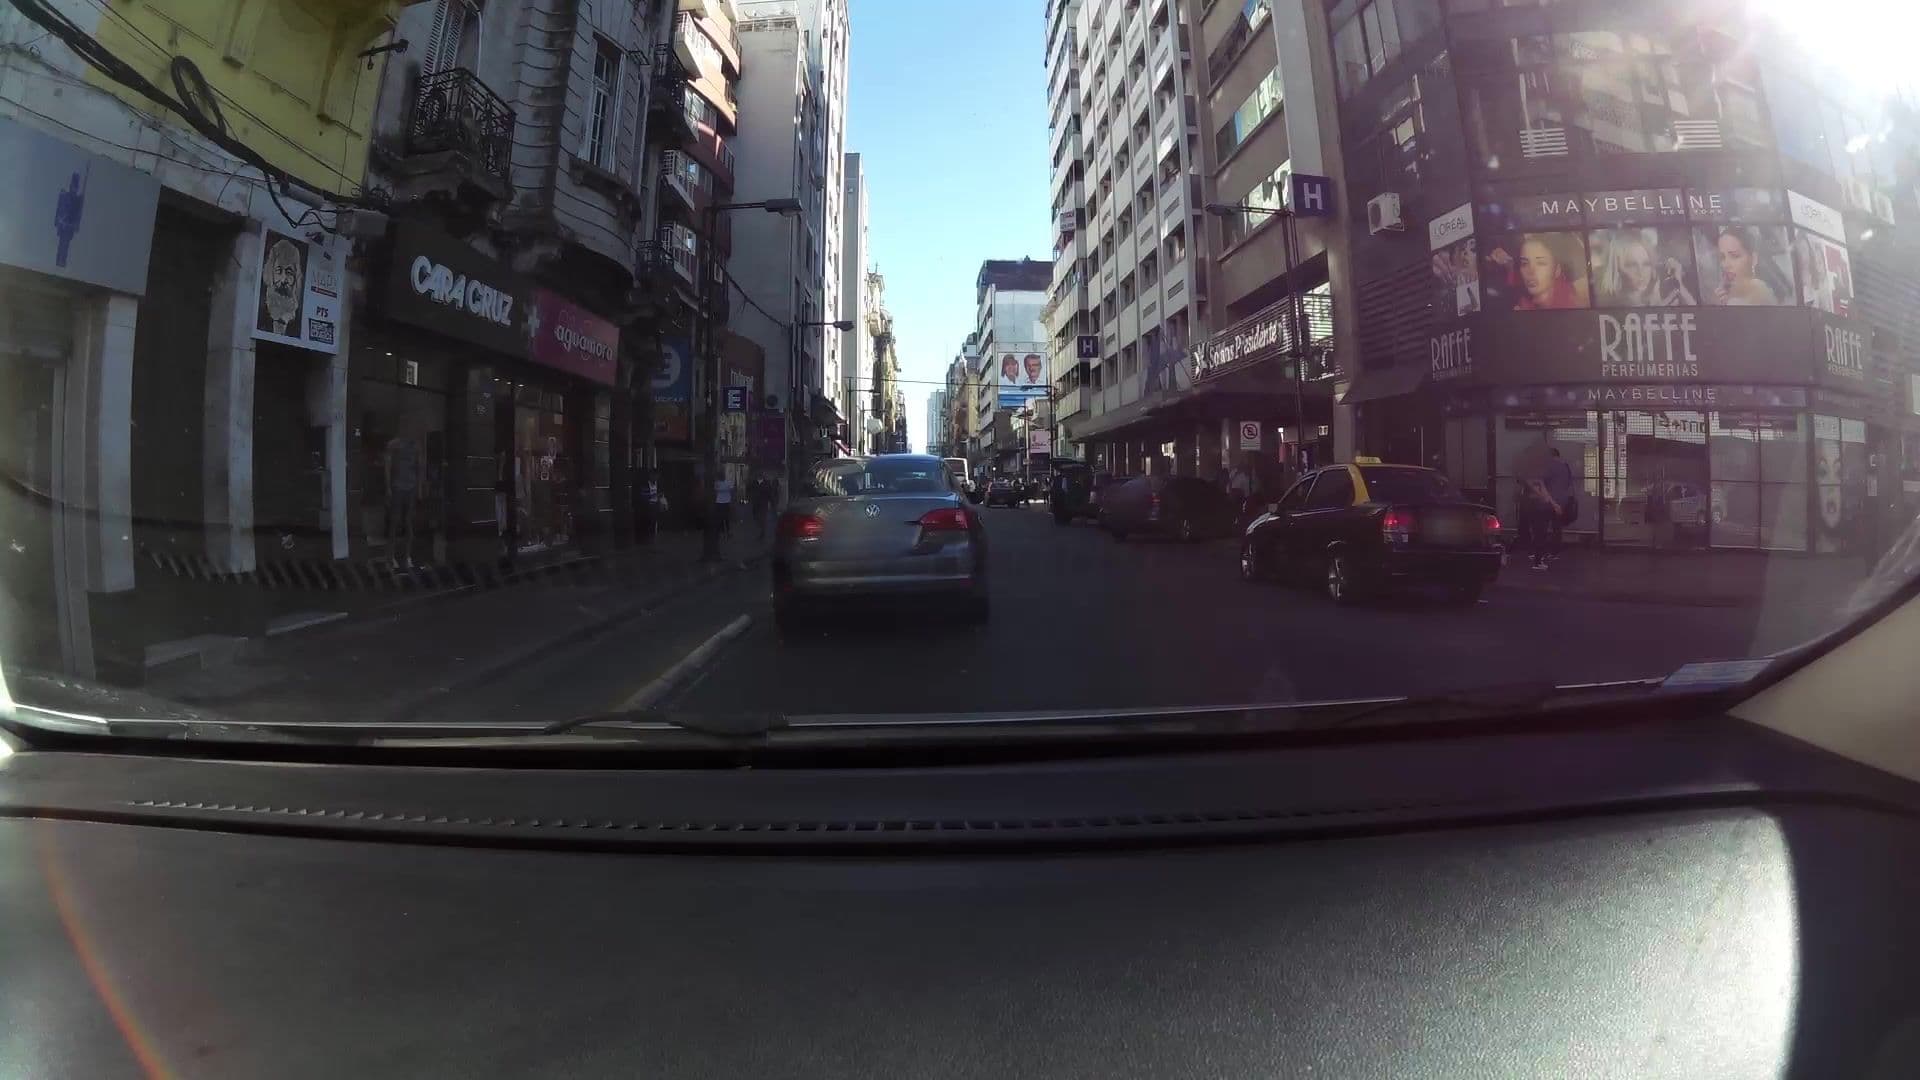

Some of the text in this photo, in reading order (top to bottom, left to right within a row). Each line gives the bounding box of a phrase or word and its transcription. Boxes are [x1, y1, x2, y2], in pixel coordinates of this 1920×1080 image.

[1303, 183, 1323, 210] H
[1542, 194, 1721, 215] MAYBELLINE
[410, 255, 513, 326] CARA CRUZ
[555, 325, 614, 361] aguamora
[1083, 339, 1093, 353] H
[1431, 327, 1472, 371] RAFFE
[1599, 313, 1697, 361] RAFFE
[1824, 324, 1863, 369] RAFFE
[1602, 363, 1698, 376] PERFUMERIAS
[727, 389, 741, 409] E
[1587, 387, 1714, 401] MAYBELLINE
